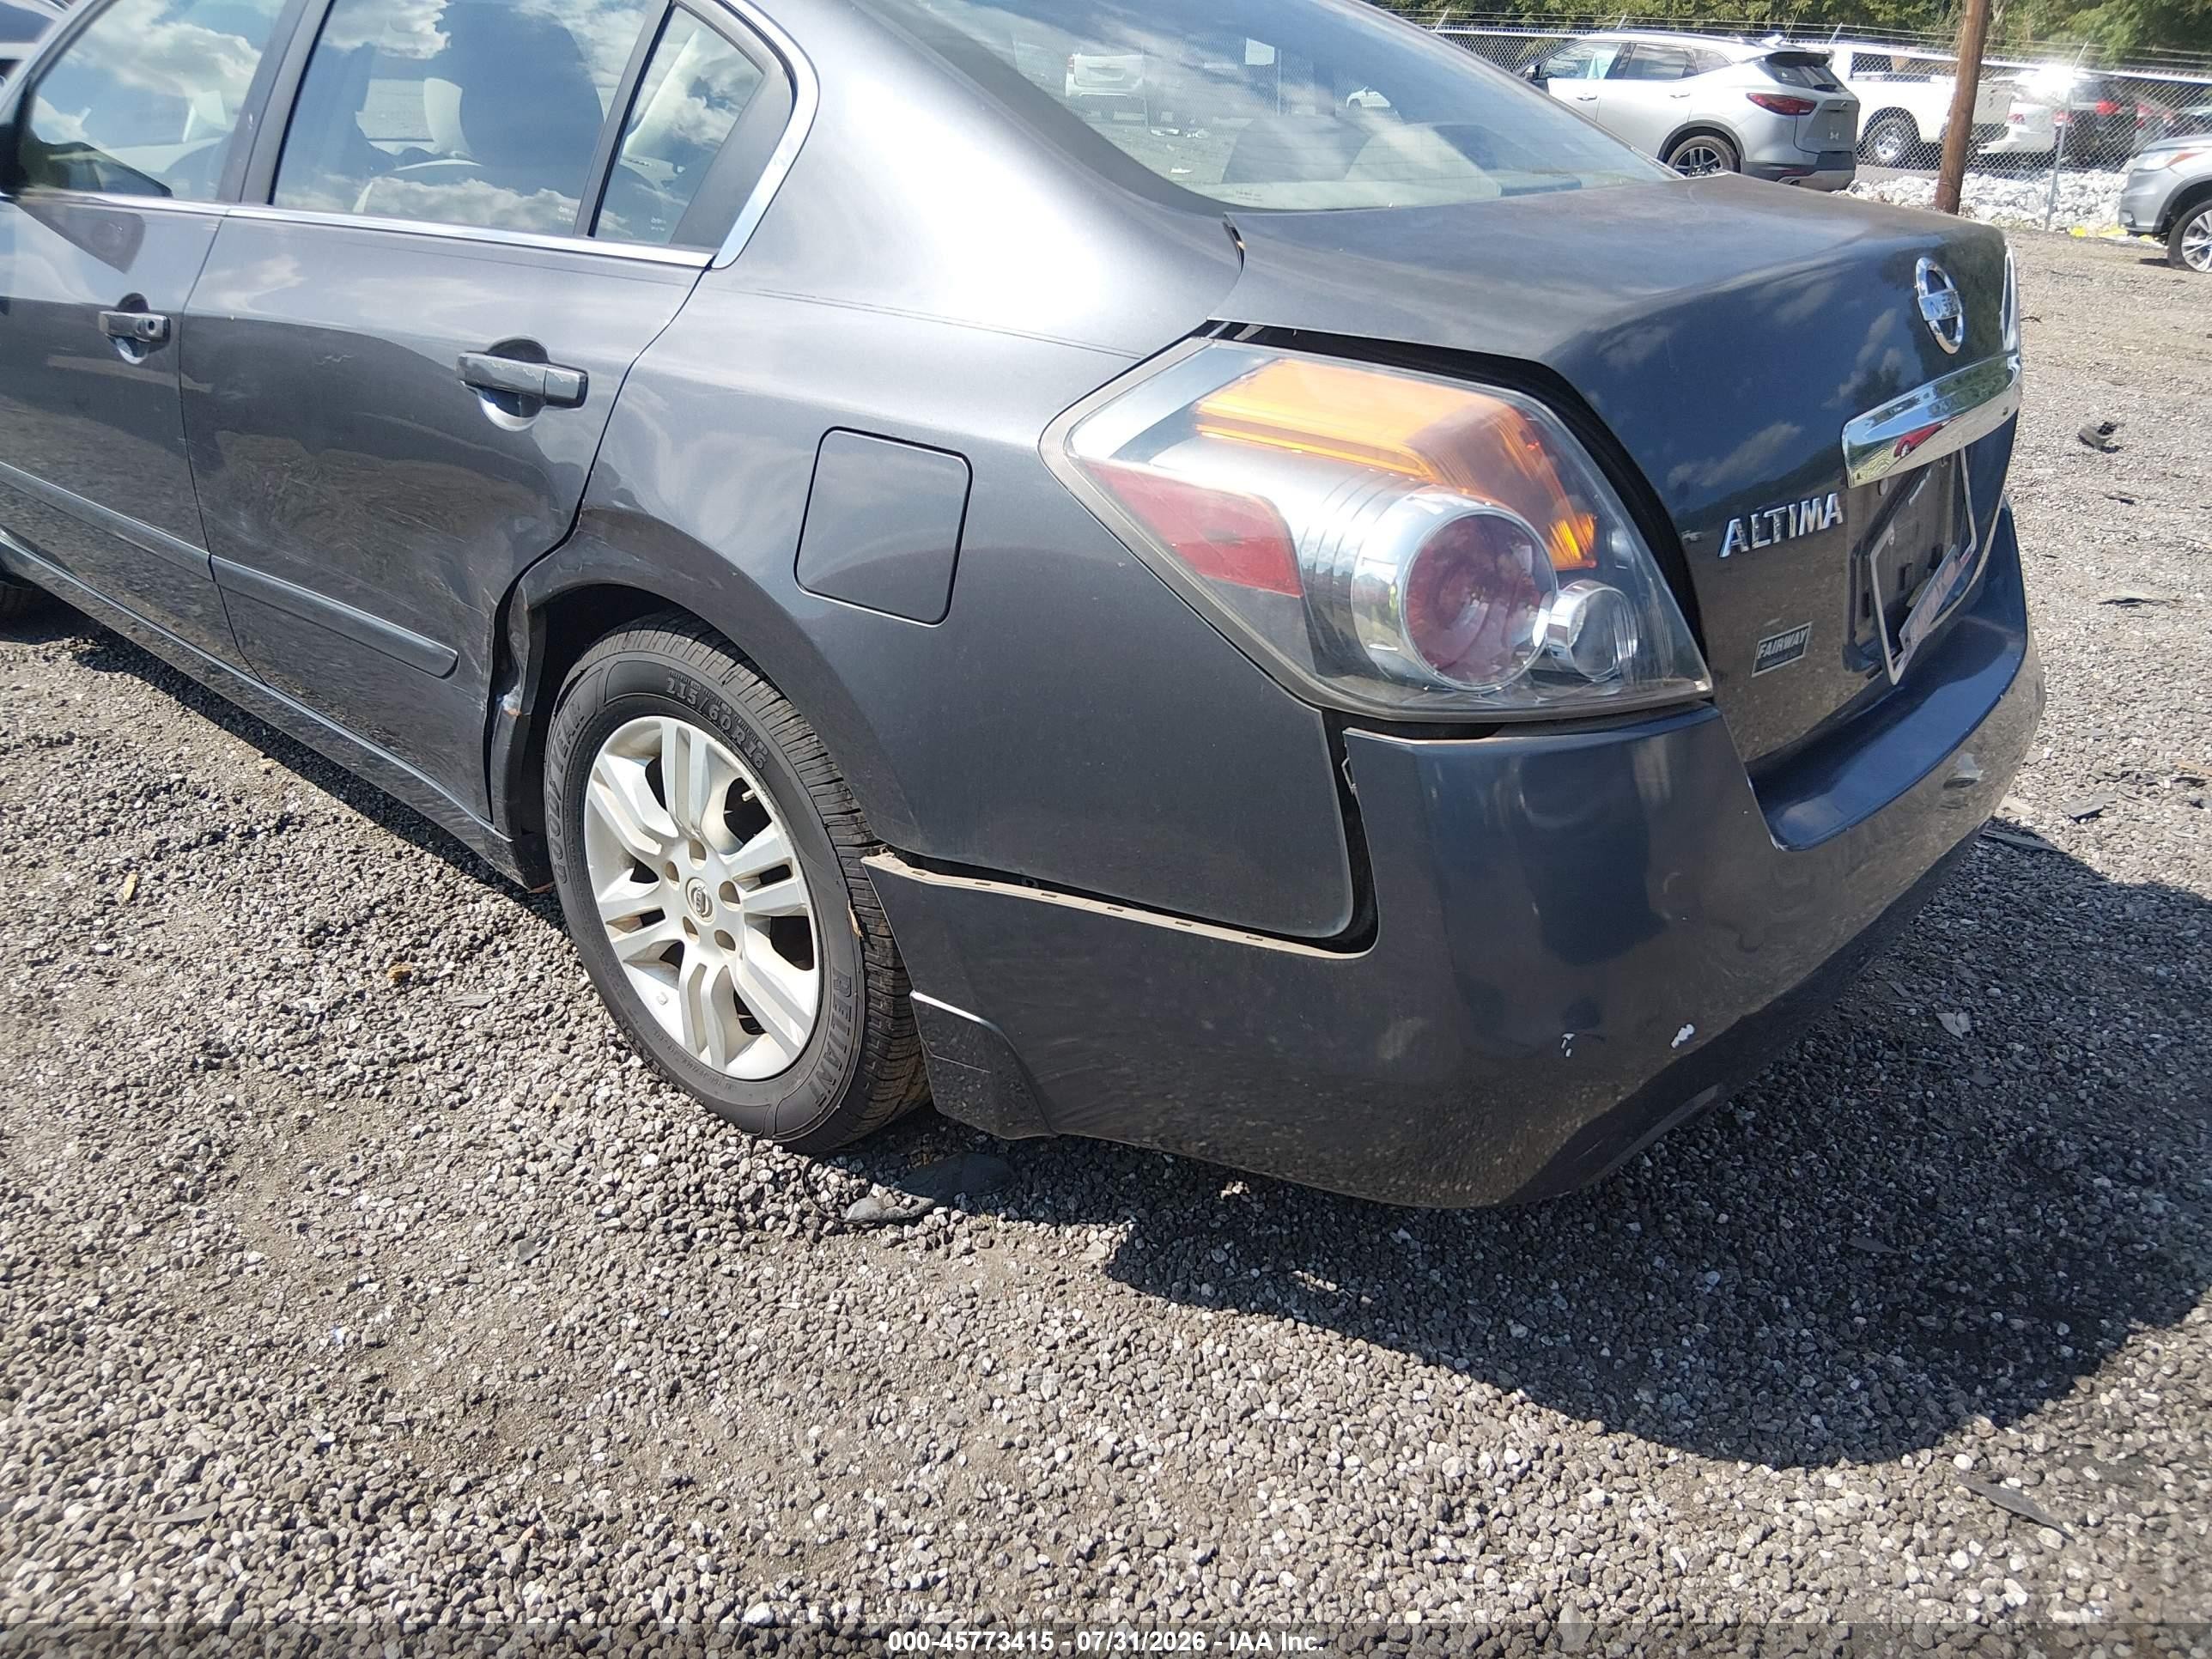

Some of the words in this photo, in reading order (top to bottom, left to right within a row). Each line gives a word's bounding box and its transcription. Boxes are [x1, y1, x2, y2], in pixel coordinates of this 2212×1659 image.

[1718, 492, 1844, 558] ALTIMA
[1757, 628, 1808, 659] FAIRWAY
[808, 966, 852, 1108] RELIANT
